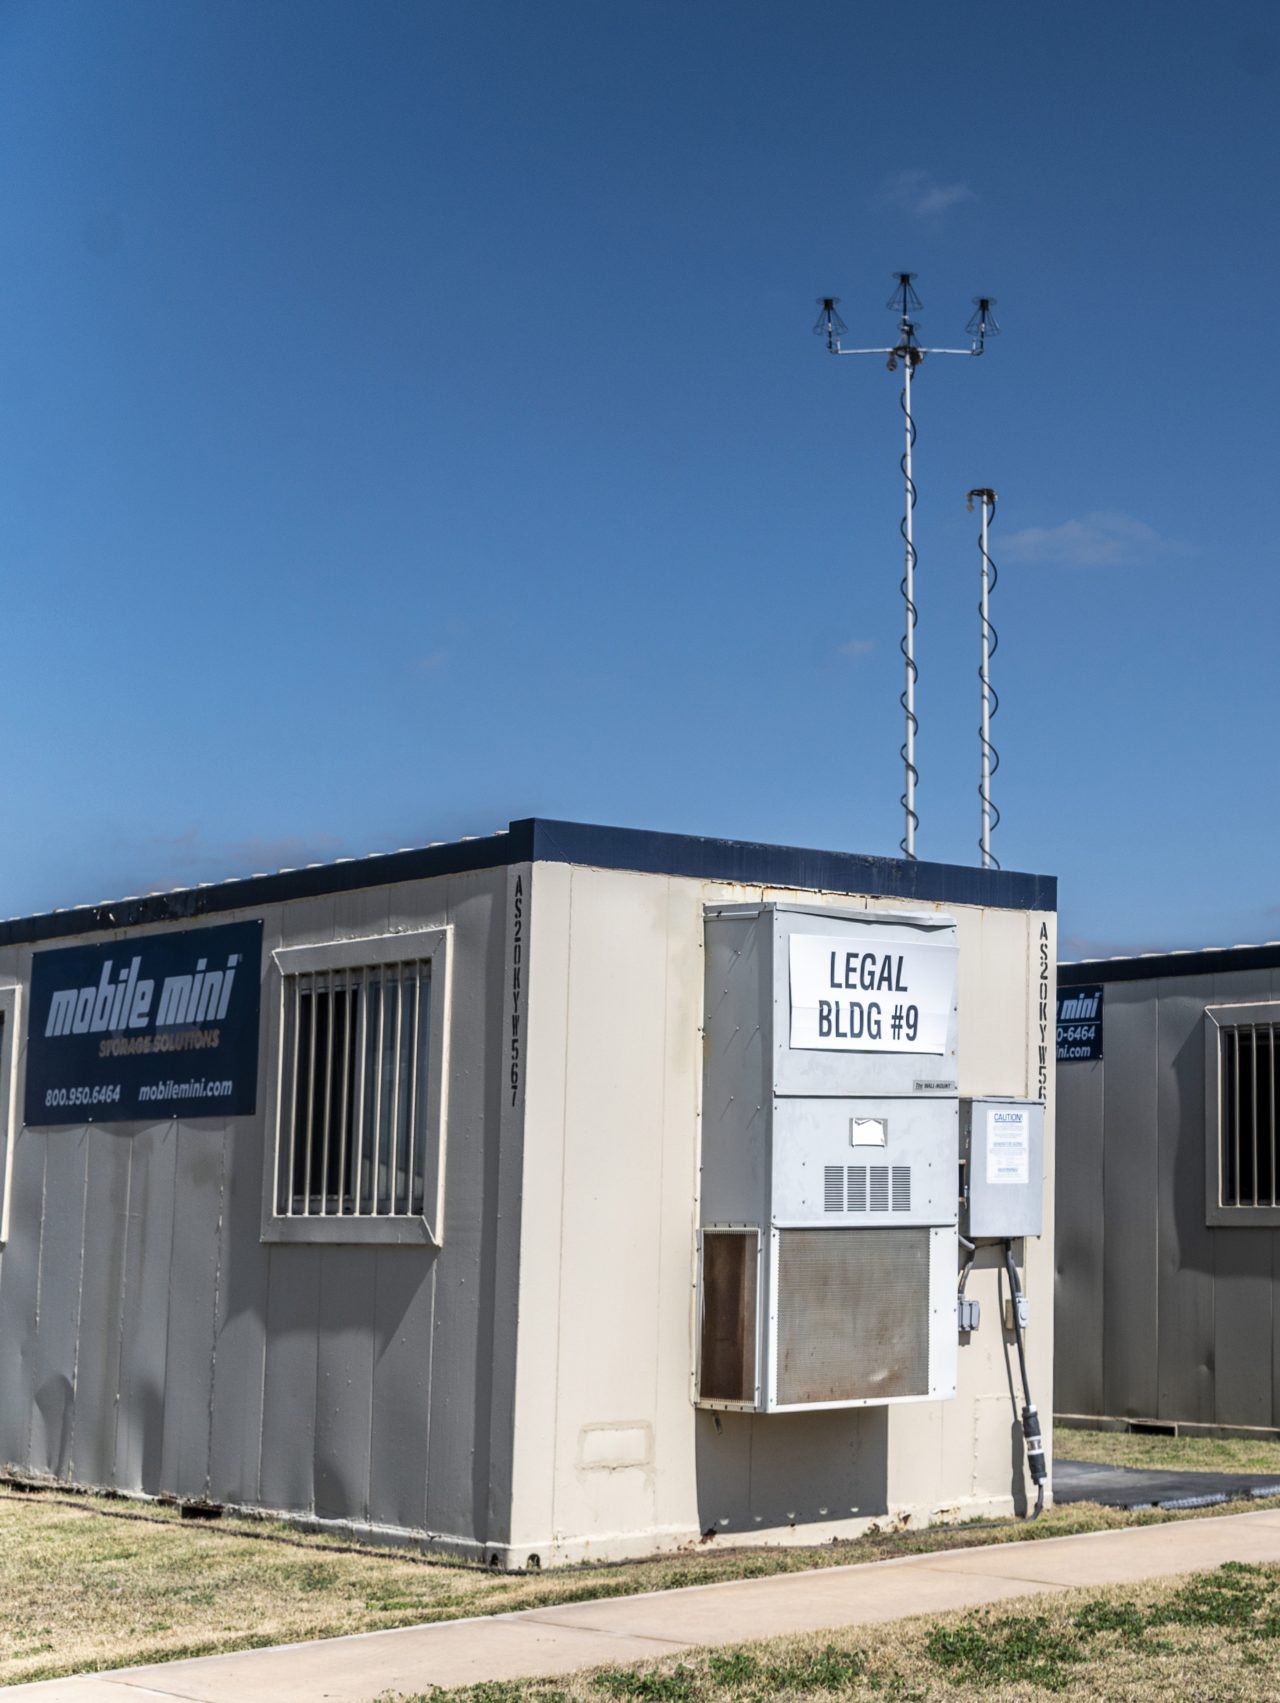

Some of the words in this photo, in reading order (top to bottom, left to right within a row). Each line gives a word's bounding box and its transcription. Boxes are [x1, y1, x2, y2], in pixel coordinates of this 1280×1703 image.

[830, 951, 908, 992] LEGAL
[45, 956, 154, 1037] mobile
[156, 954, 238, 1026] mini
[1060, 992, 1100, 1020] mini
[818, 1000, 882, 1040] BLDG
[891, 1004, 919, 1041] #9
[99, 1035, 152, 1057] STORAGE
[154, 1029, 220, 1053] SOLUTIONS
[45, 1084, 121, 1106] 800.950.6464
[138, 1078, 233, 1101] mobilemini.com
